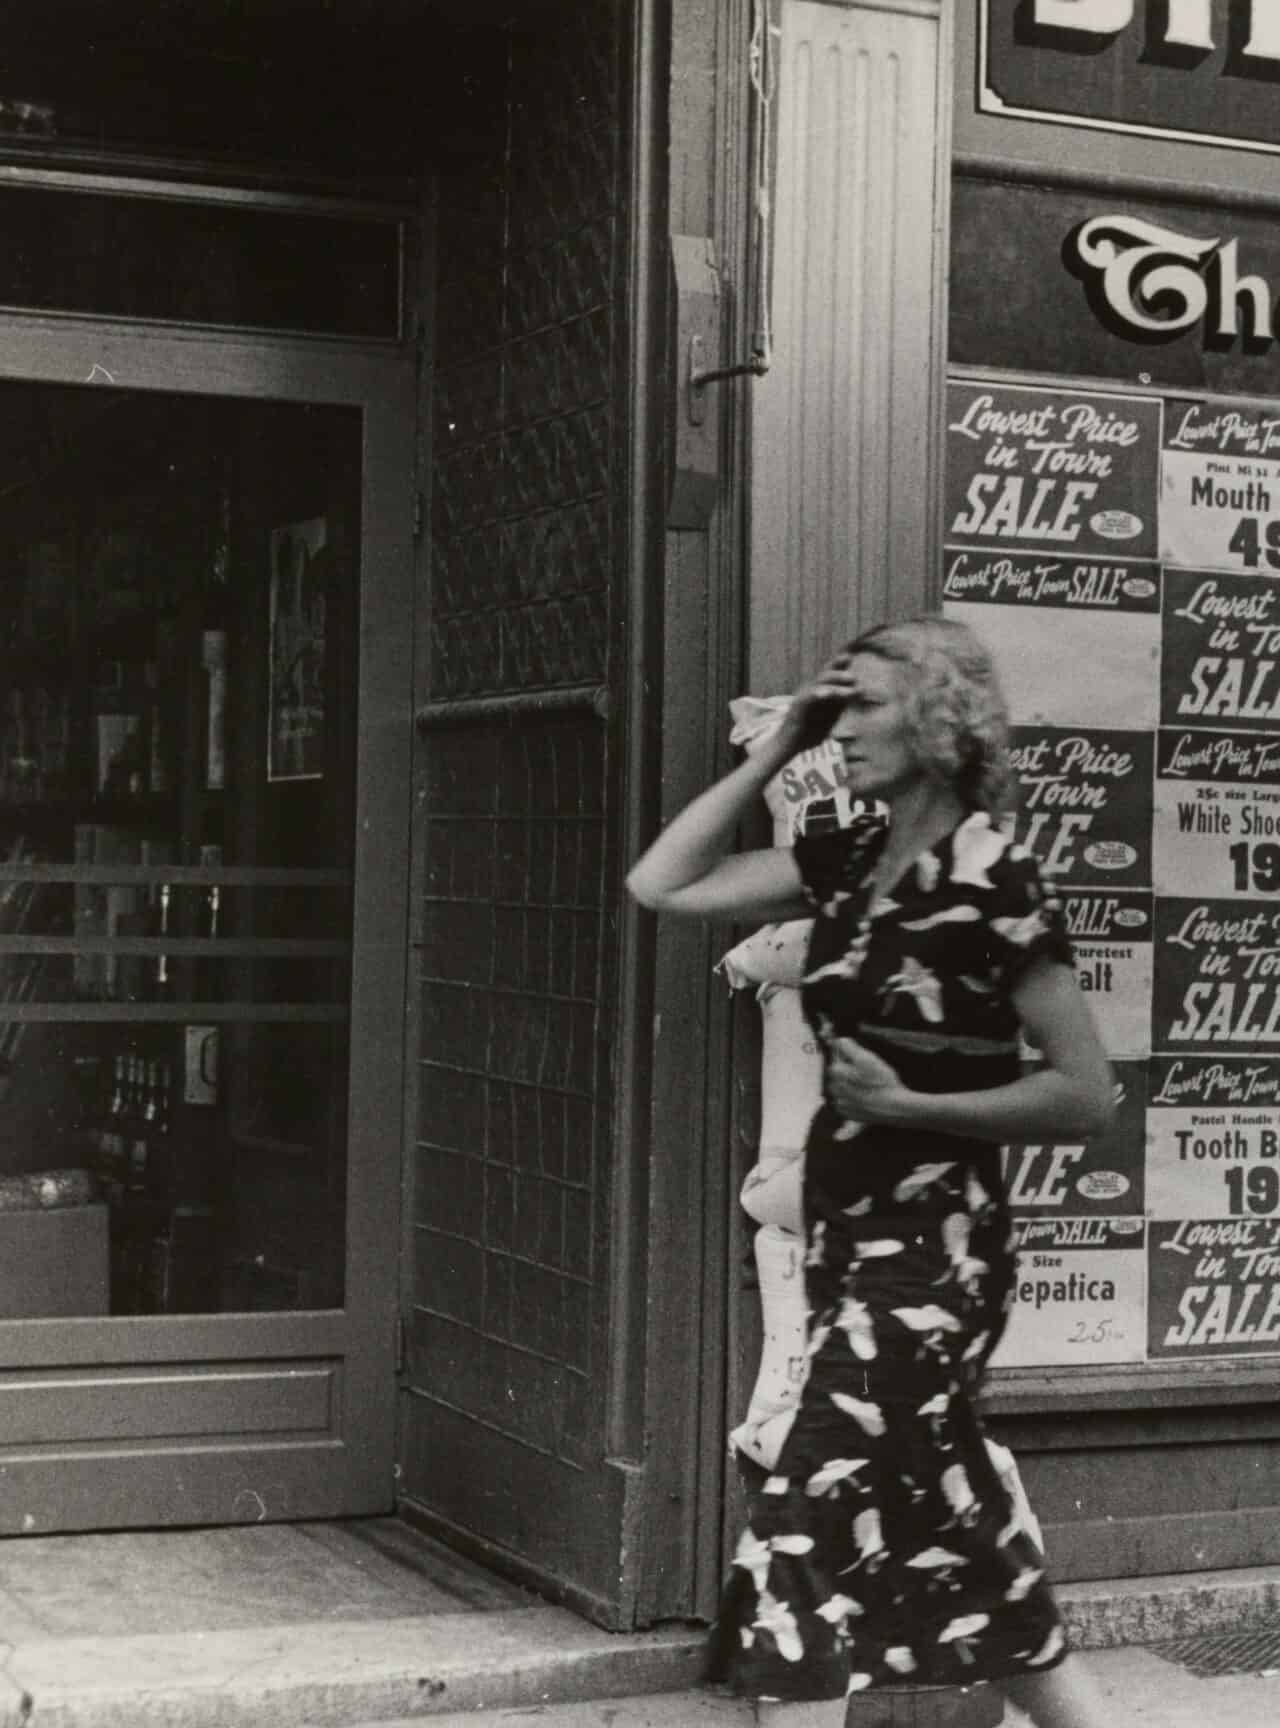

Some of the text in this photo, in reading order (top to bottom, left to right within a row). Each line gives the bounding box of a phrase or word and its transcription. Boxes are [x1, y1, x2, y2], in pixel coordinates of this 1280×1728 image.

[949, 395, 1139, 446] Lowest Price
[986, 437, 1112, 477] in Town
[952, 473, 1098, 541] SALE
[1191, 475, 1270, 512] Mouth
[1175, 580, 1270, 624] Lowest
[1209, 623, 1240, 652] in
[1212, 739, 1250, 774] Price
[1178, 802, 1231, 834] White
[1232, 1115, 1273, 1125] Handle
[1175, 1130, 1248, 1160] Tooth
[1032, 1256, 1063, 1268] Size
[1012, 1272, 1116, 1310] epatica
